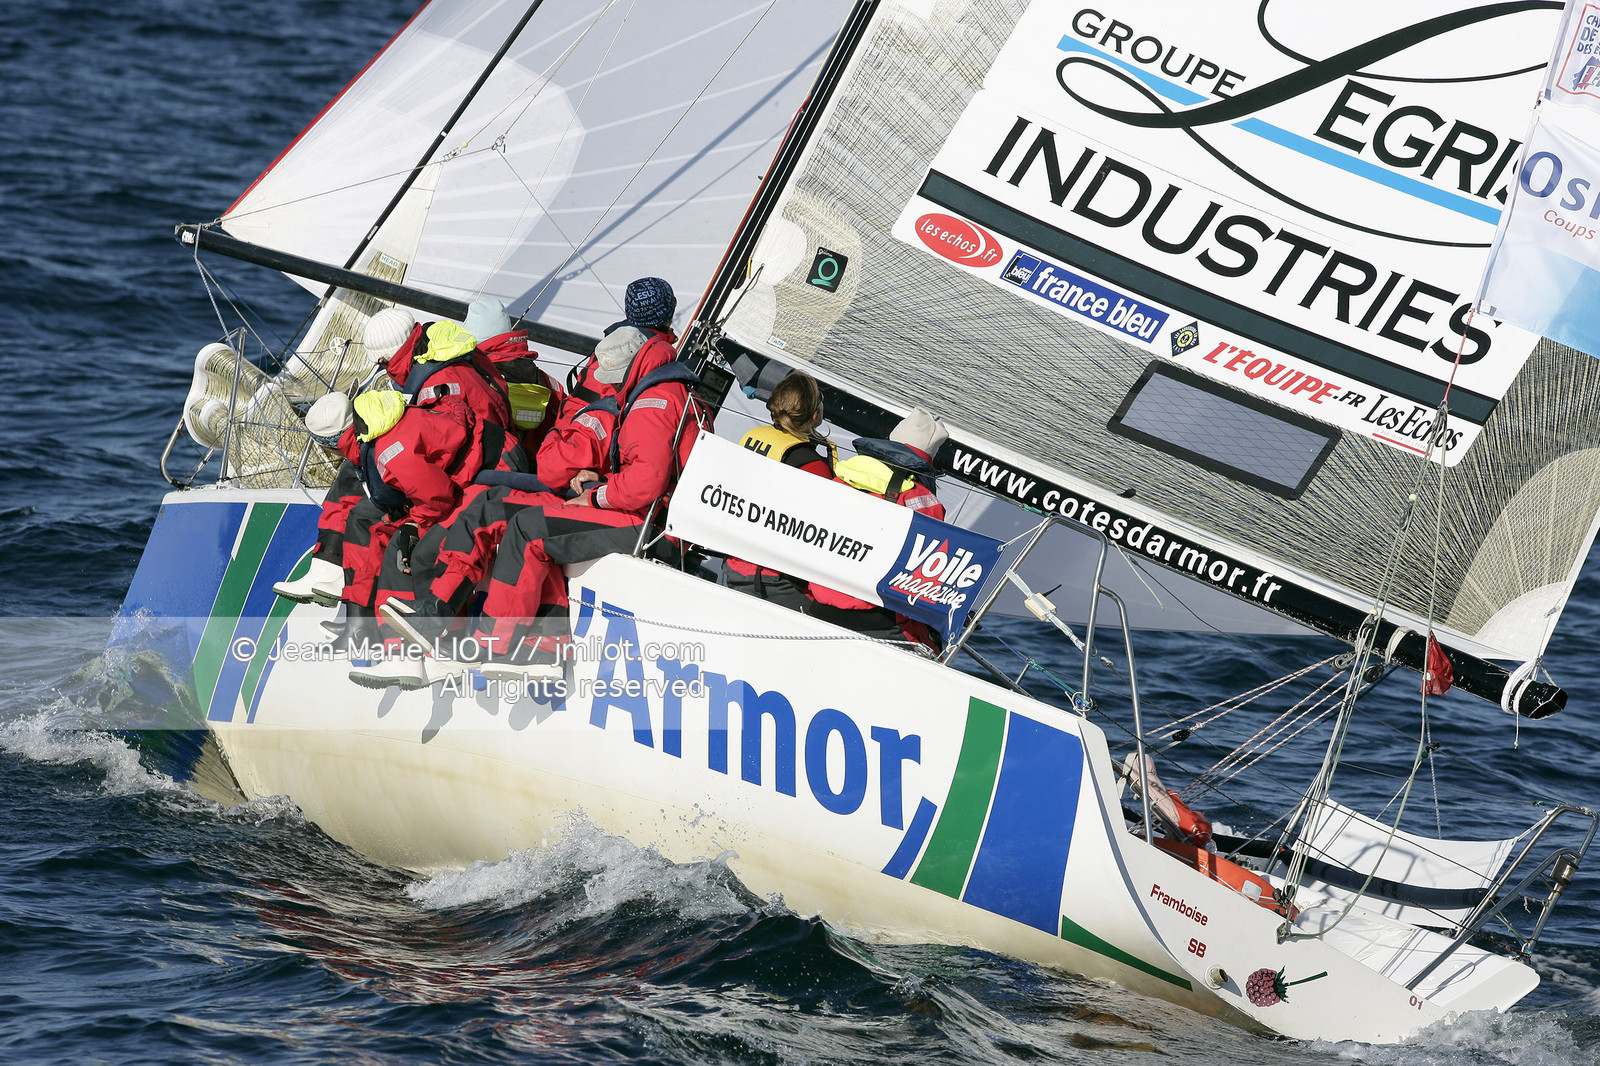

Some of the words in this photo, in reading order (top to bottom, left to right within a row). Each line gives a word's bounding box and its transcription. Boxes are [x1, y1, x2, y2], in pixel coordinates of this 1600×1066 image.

[1071, 8, 1246, 97] GROUPE
[1576, 41, 1593, 55] DES
[1580, 26, 1599, 42] DE
[920, 218, 937, 236] les
[982, 115, 1500, 366] INDUSTRIES
[1543, 209, 1597, 240] Coups
[381, 255, 399, 268] HEAD
[1032, 267, 1108, 318] france
[1106, 298, 1159, 343] bleu
[700, 484, 746, 519] CÔTES
[748, 502, 828, 549] D'ARMOR
[829, 539, 875, 563] VERT
[951, 448, 1282, 603] www.cotesdarmor.fr
[903, 531, 984, 589] Voile
[888, 569, 968, 610] magazine
[1150, 883, 1209, 927] Framboise
[1187, 937, 1207, 959] SB
